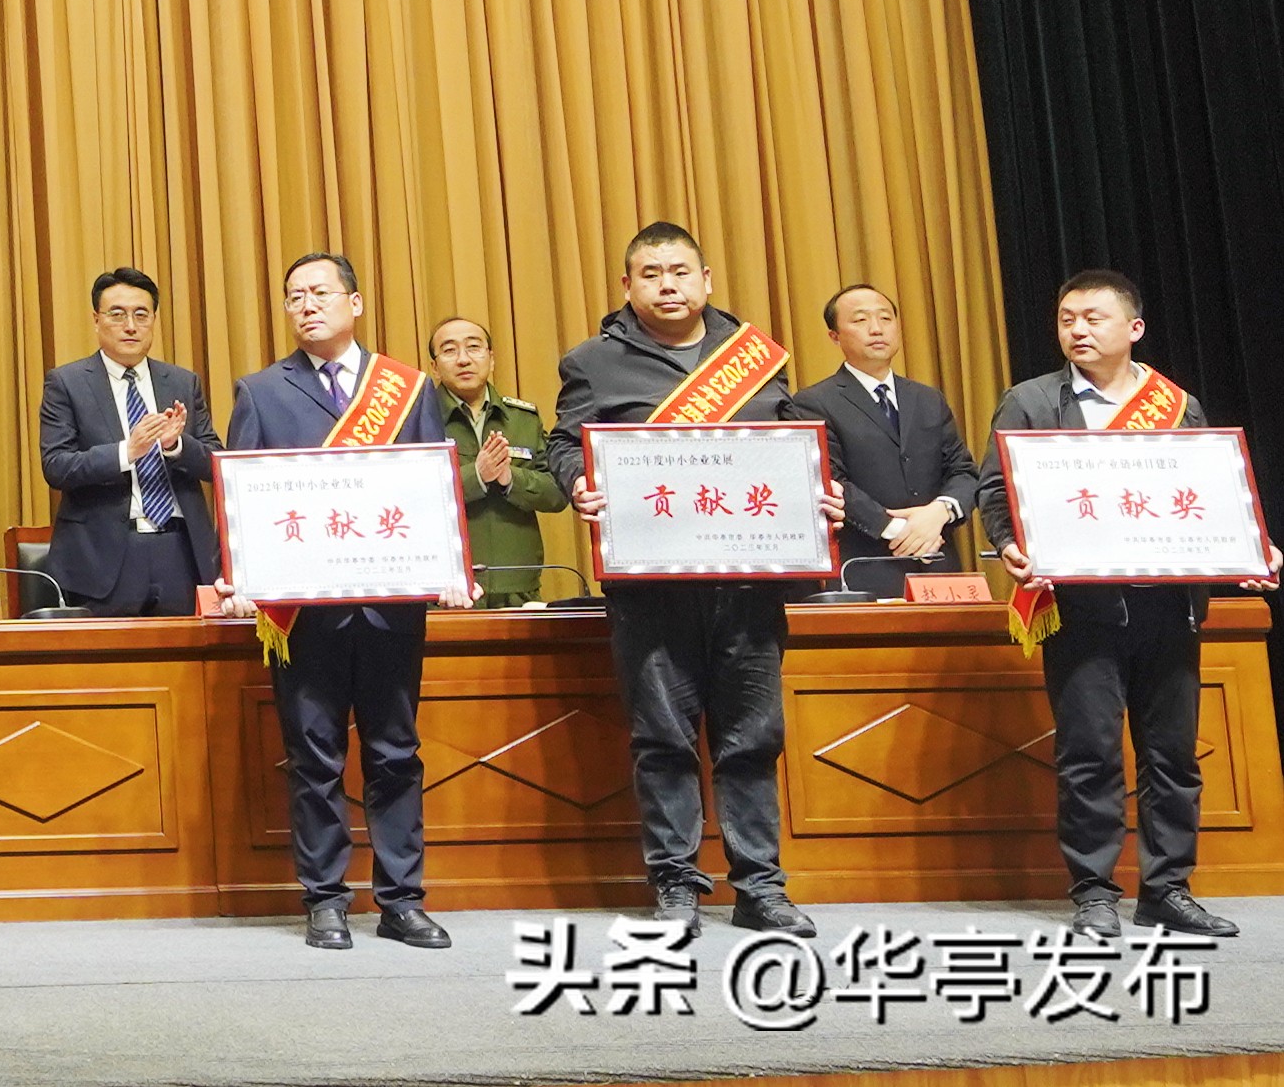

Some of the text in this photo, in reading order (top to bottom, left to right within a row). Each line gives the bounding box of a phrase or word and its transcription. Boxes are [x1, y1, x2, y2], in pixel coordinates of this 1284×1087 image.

[618, 454, 733, 466] 2022年度中小企业发展
[644, 483, 778, 518] 贡献奖
[1066, 487, 1205, 521] 贡献奖
[274, 505, 411, 543] 贡献奖
